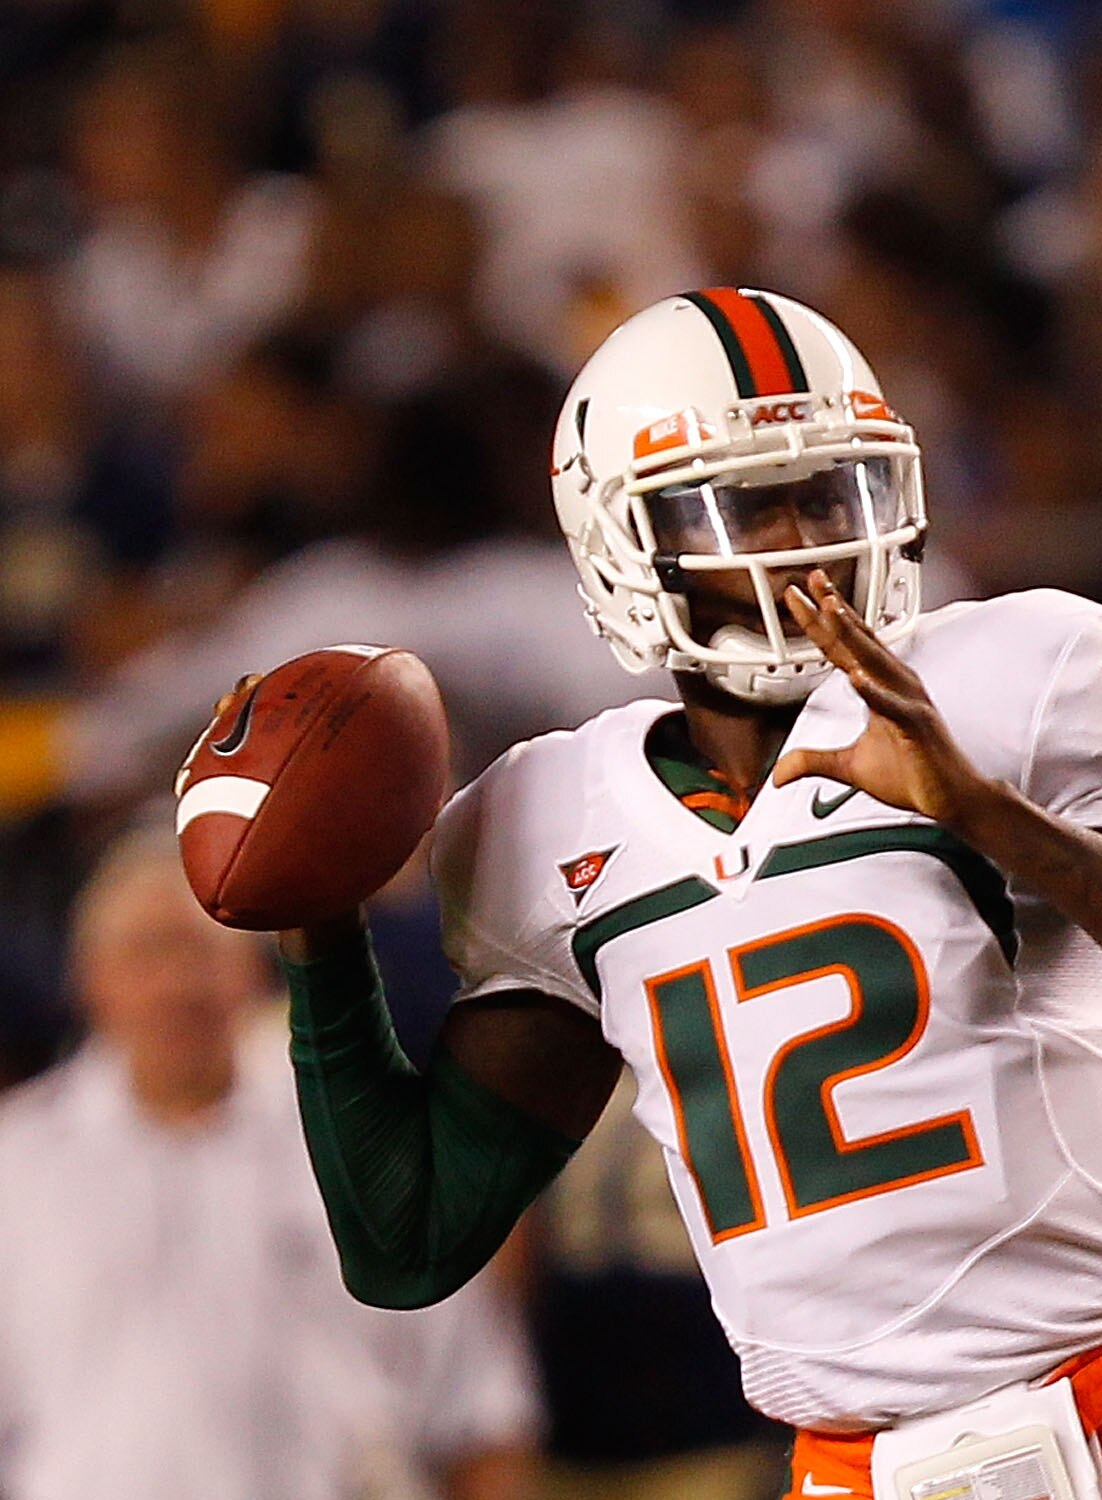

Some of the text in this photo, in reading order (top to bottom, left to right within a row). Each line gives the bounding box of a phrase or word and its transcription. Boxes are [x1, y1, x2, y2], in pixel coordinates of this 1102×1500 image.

[751, 401, 808, 425] ACC
[574, 863, 597, 885] ACC
[713, 845, 750, 880] U
[643, 912, 985, 1246] 12
